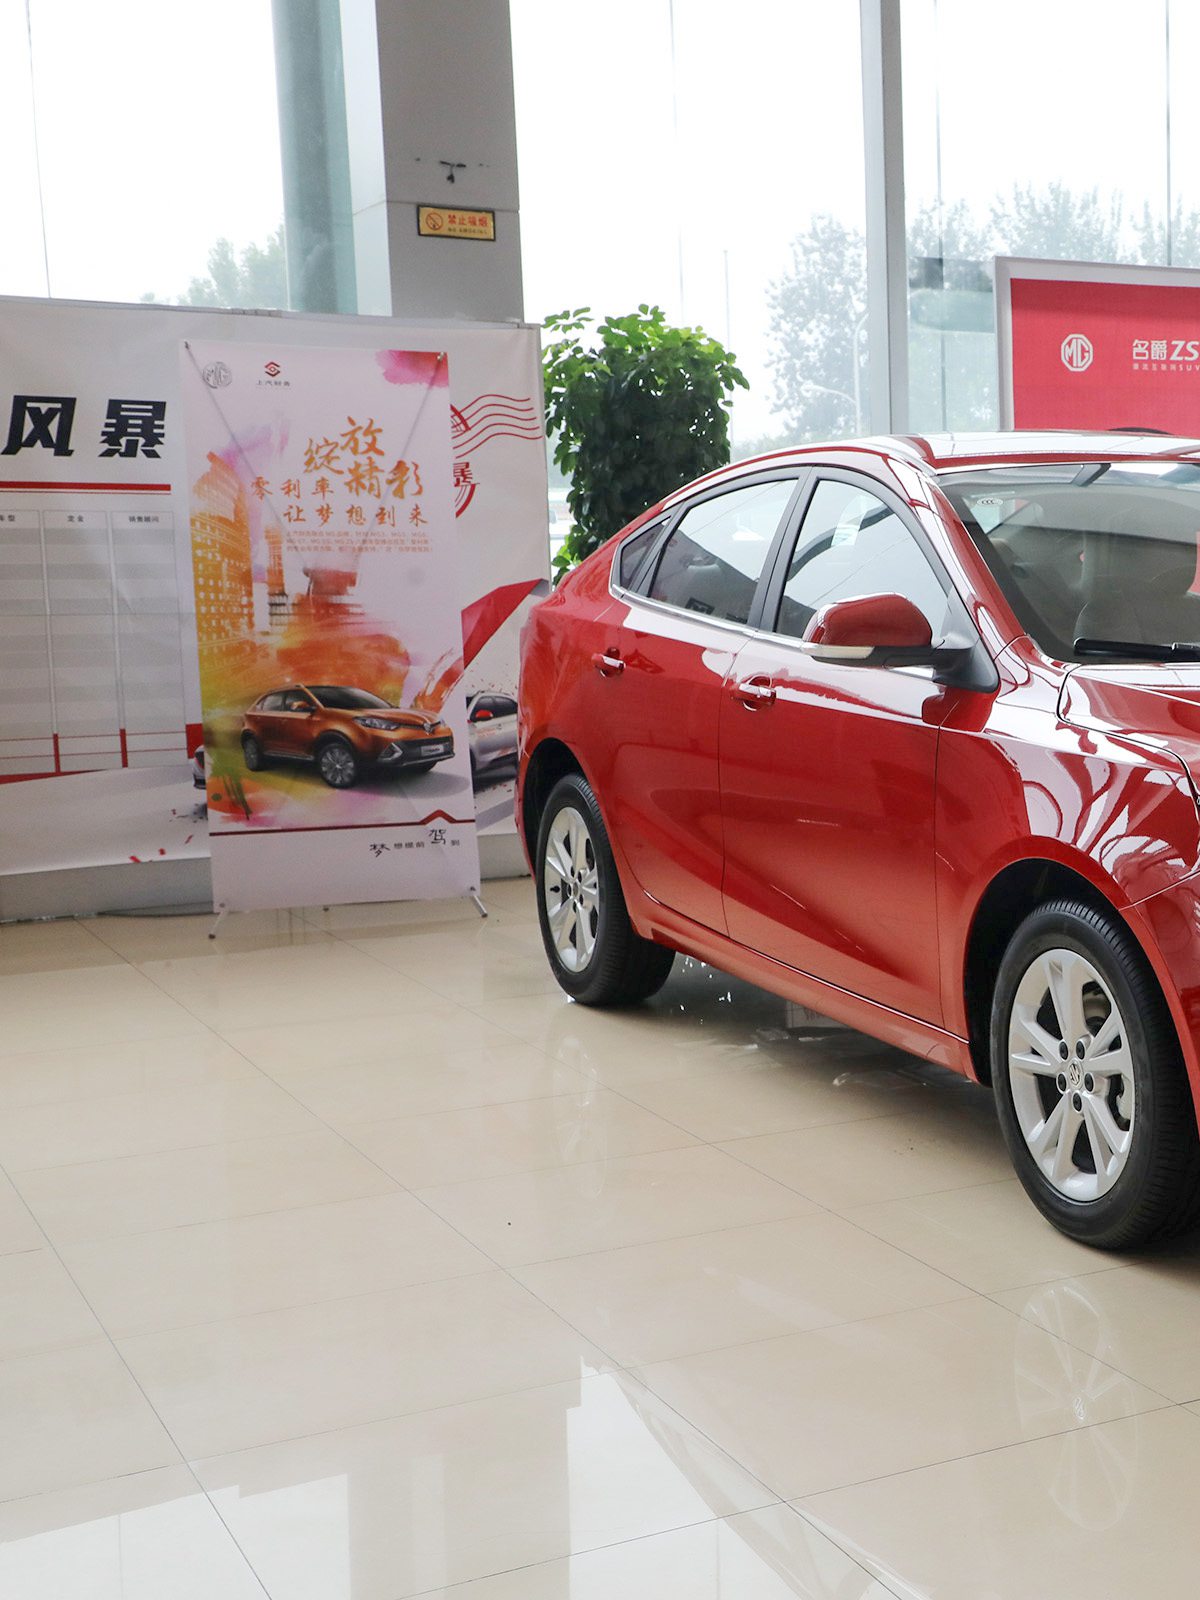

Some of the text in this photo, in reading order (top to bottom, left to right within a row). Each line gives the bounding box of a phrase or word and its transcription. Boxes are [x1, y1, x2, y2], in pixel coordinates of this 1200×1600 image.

[1, 395, 167, 458] 风暴
[283, 504, 428, 527] 让梦想到来
